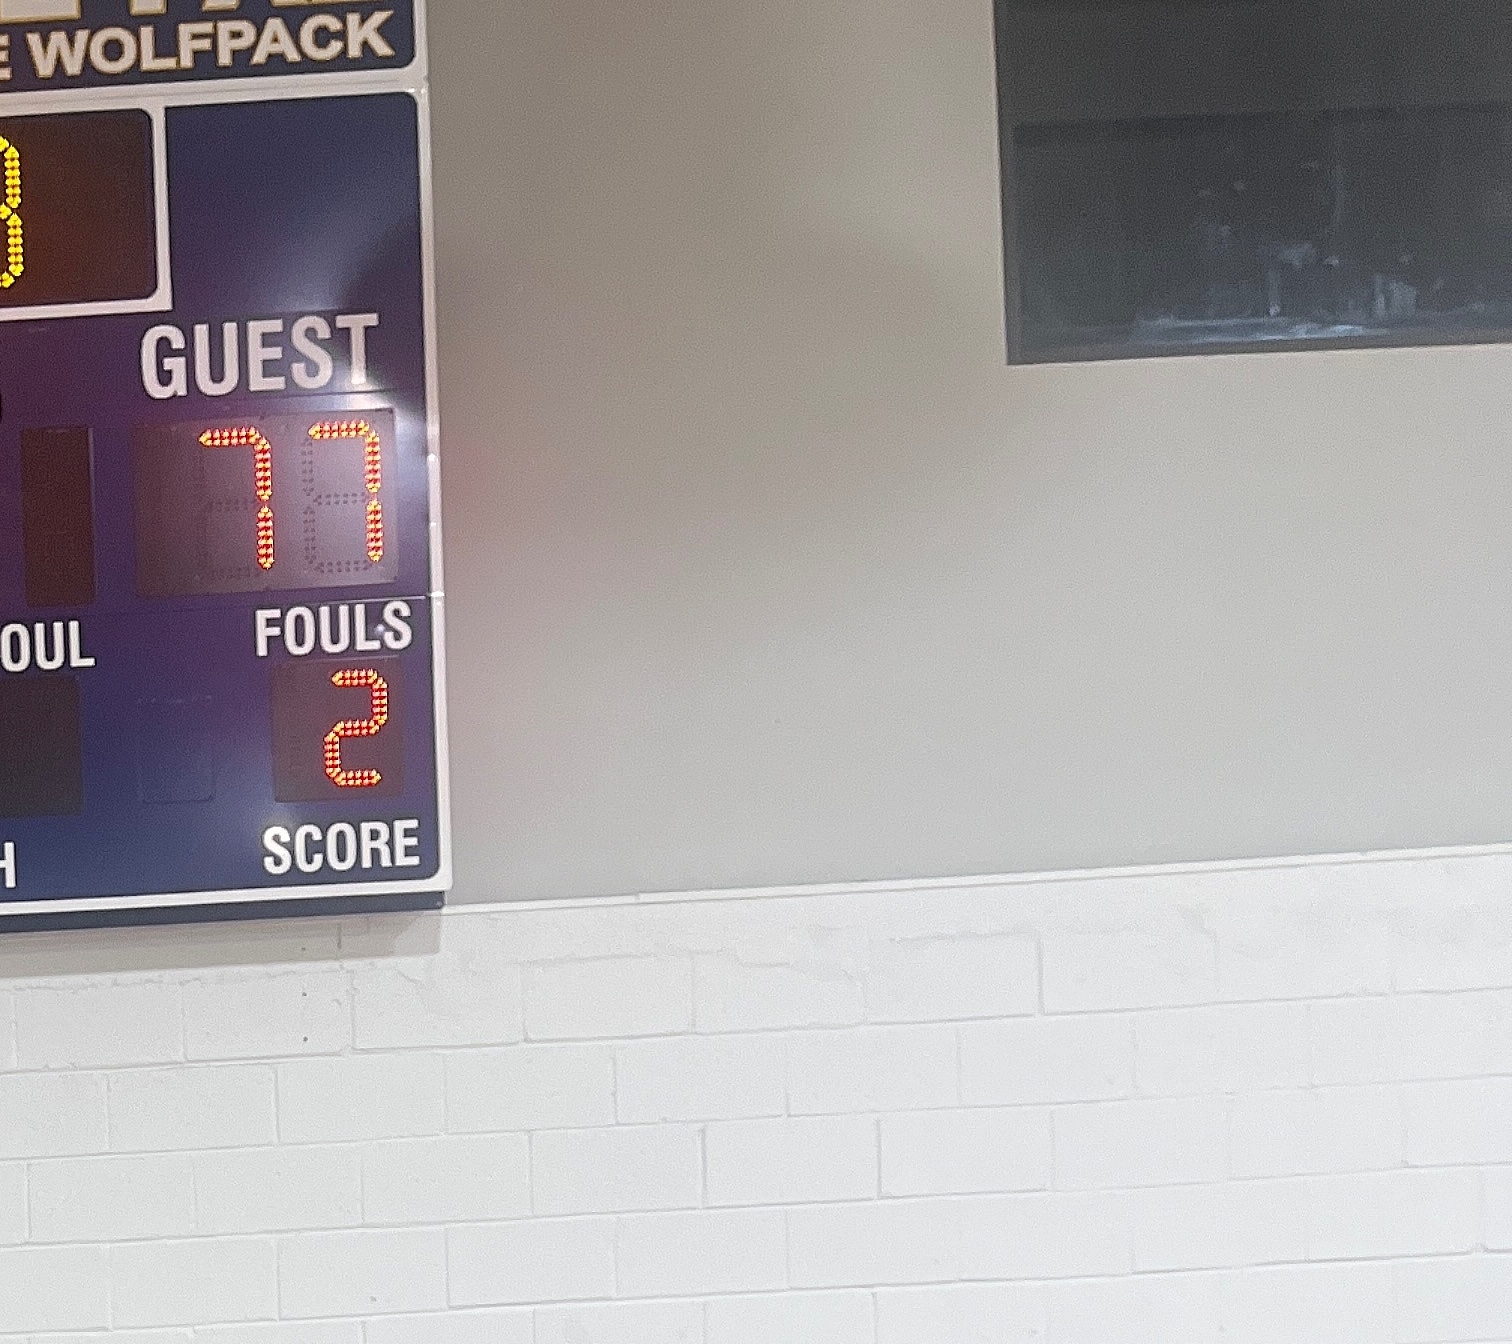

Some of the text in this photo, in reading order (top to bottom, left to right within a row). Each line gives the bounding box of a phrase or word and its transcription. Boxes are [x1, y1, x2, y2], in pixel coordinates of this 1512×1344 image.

[26, 11, 395, 80] WOLFPACK
[139, 312, 379, 399] GUEST
[198, 420, 383, 569] 77
[255, 600, 413, 657] FOULS
[323, 668, 389, 787] 2
[263, 819, 420, 875] SCORE
